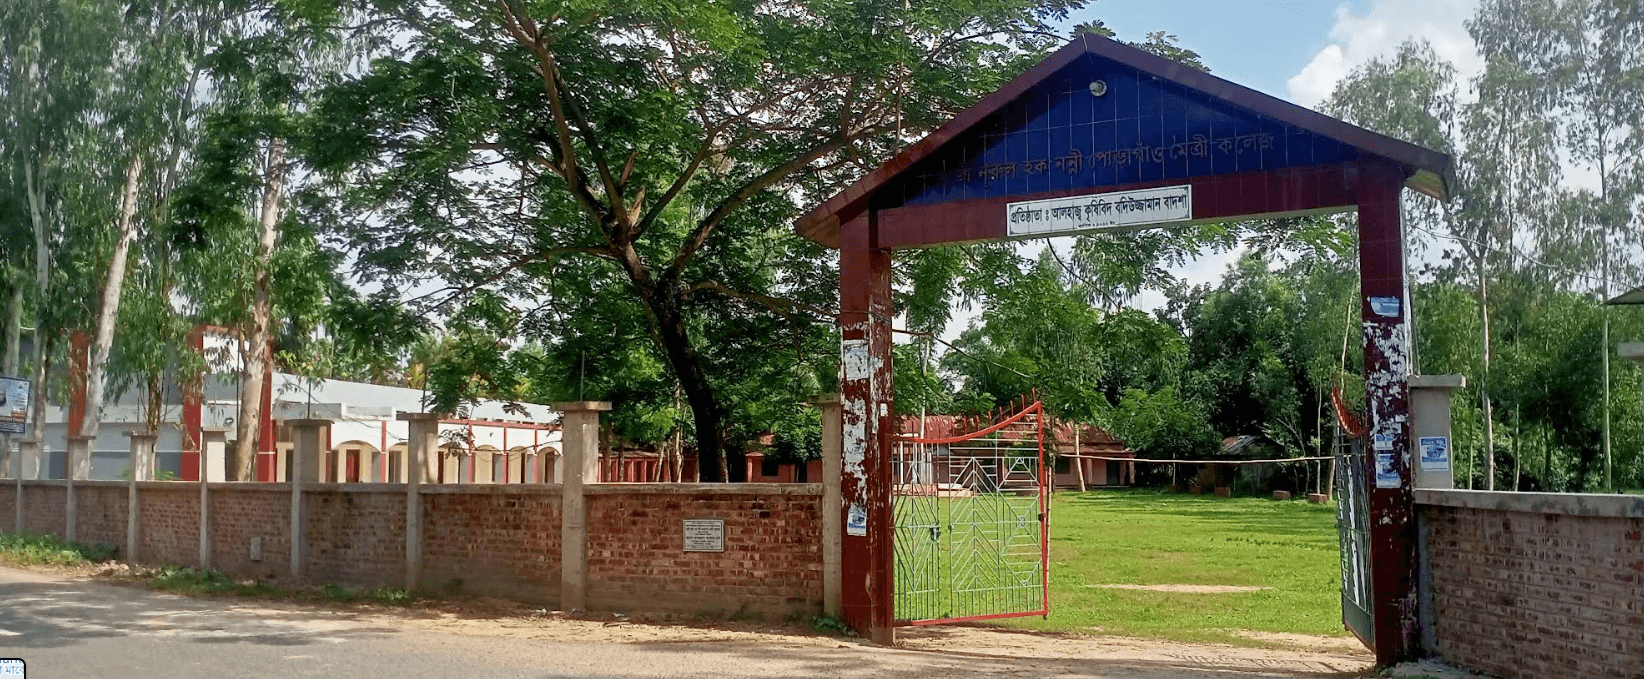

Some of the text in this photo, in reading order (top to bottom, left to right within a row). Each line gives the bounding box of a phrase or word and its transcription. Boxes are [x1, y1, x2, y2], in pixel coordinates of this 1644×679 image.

[1215, 132, 1275, 155] কলেজ
[1010, 205, 1043, 225] প্রতিষ্ঠাতা
[1163, 194, 1187, 209] বাদশা
